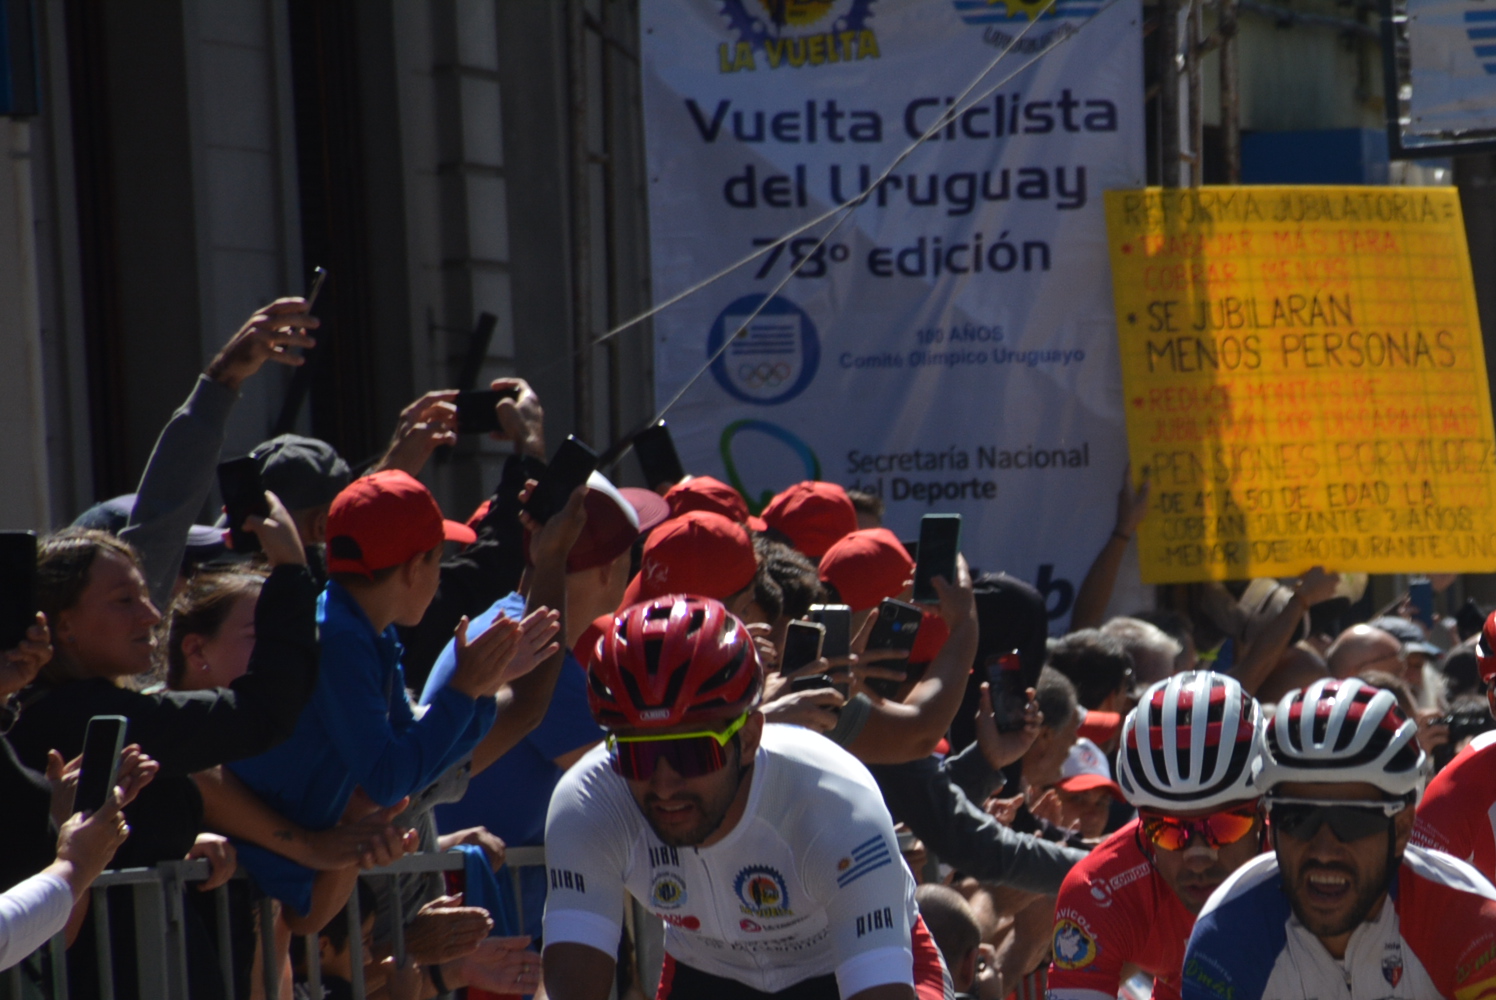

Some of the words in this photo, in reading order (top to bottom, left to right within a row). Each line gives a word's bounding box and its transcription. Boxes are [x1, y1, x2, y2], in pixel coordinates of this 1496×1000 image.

[718, 40, 756, 74] LA
[764, 29, 881, 70] VUELTA
[685, 99, 884, 144] Vuelta
[904, 89, 1119, 142] Ciclista
[724, 164, 808, 210] del
[830, 164, 1087, 216] Uruguay
[867, 231, 1052, 281] edición
[949, 324, 1005, 345] AÑOS
[1147, 301, 1182, 333] SE
[992, 345, 1086, 369] Uruguayo
[1146, 334, 1262, 373] MENOS
[1281, 331, 1457, 369] PERSONAS
[846, 445, 970, 477] Secretaría
[977, 442, 1090, 471] Nacional
[891, 477, 997, 507] Deporte
[1326, 480, 1391, 509] EDAD
[1403, 479, 1436, 503] LA
